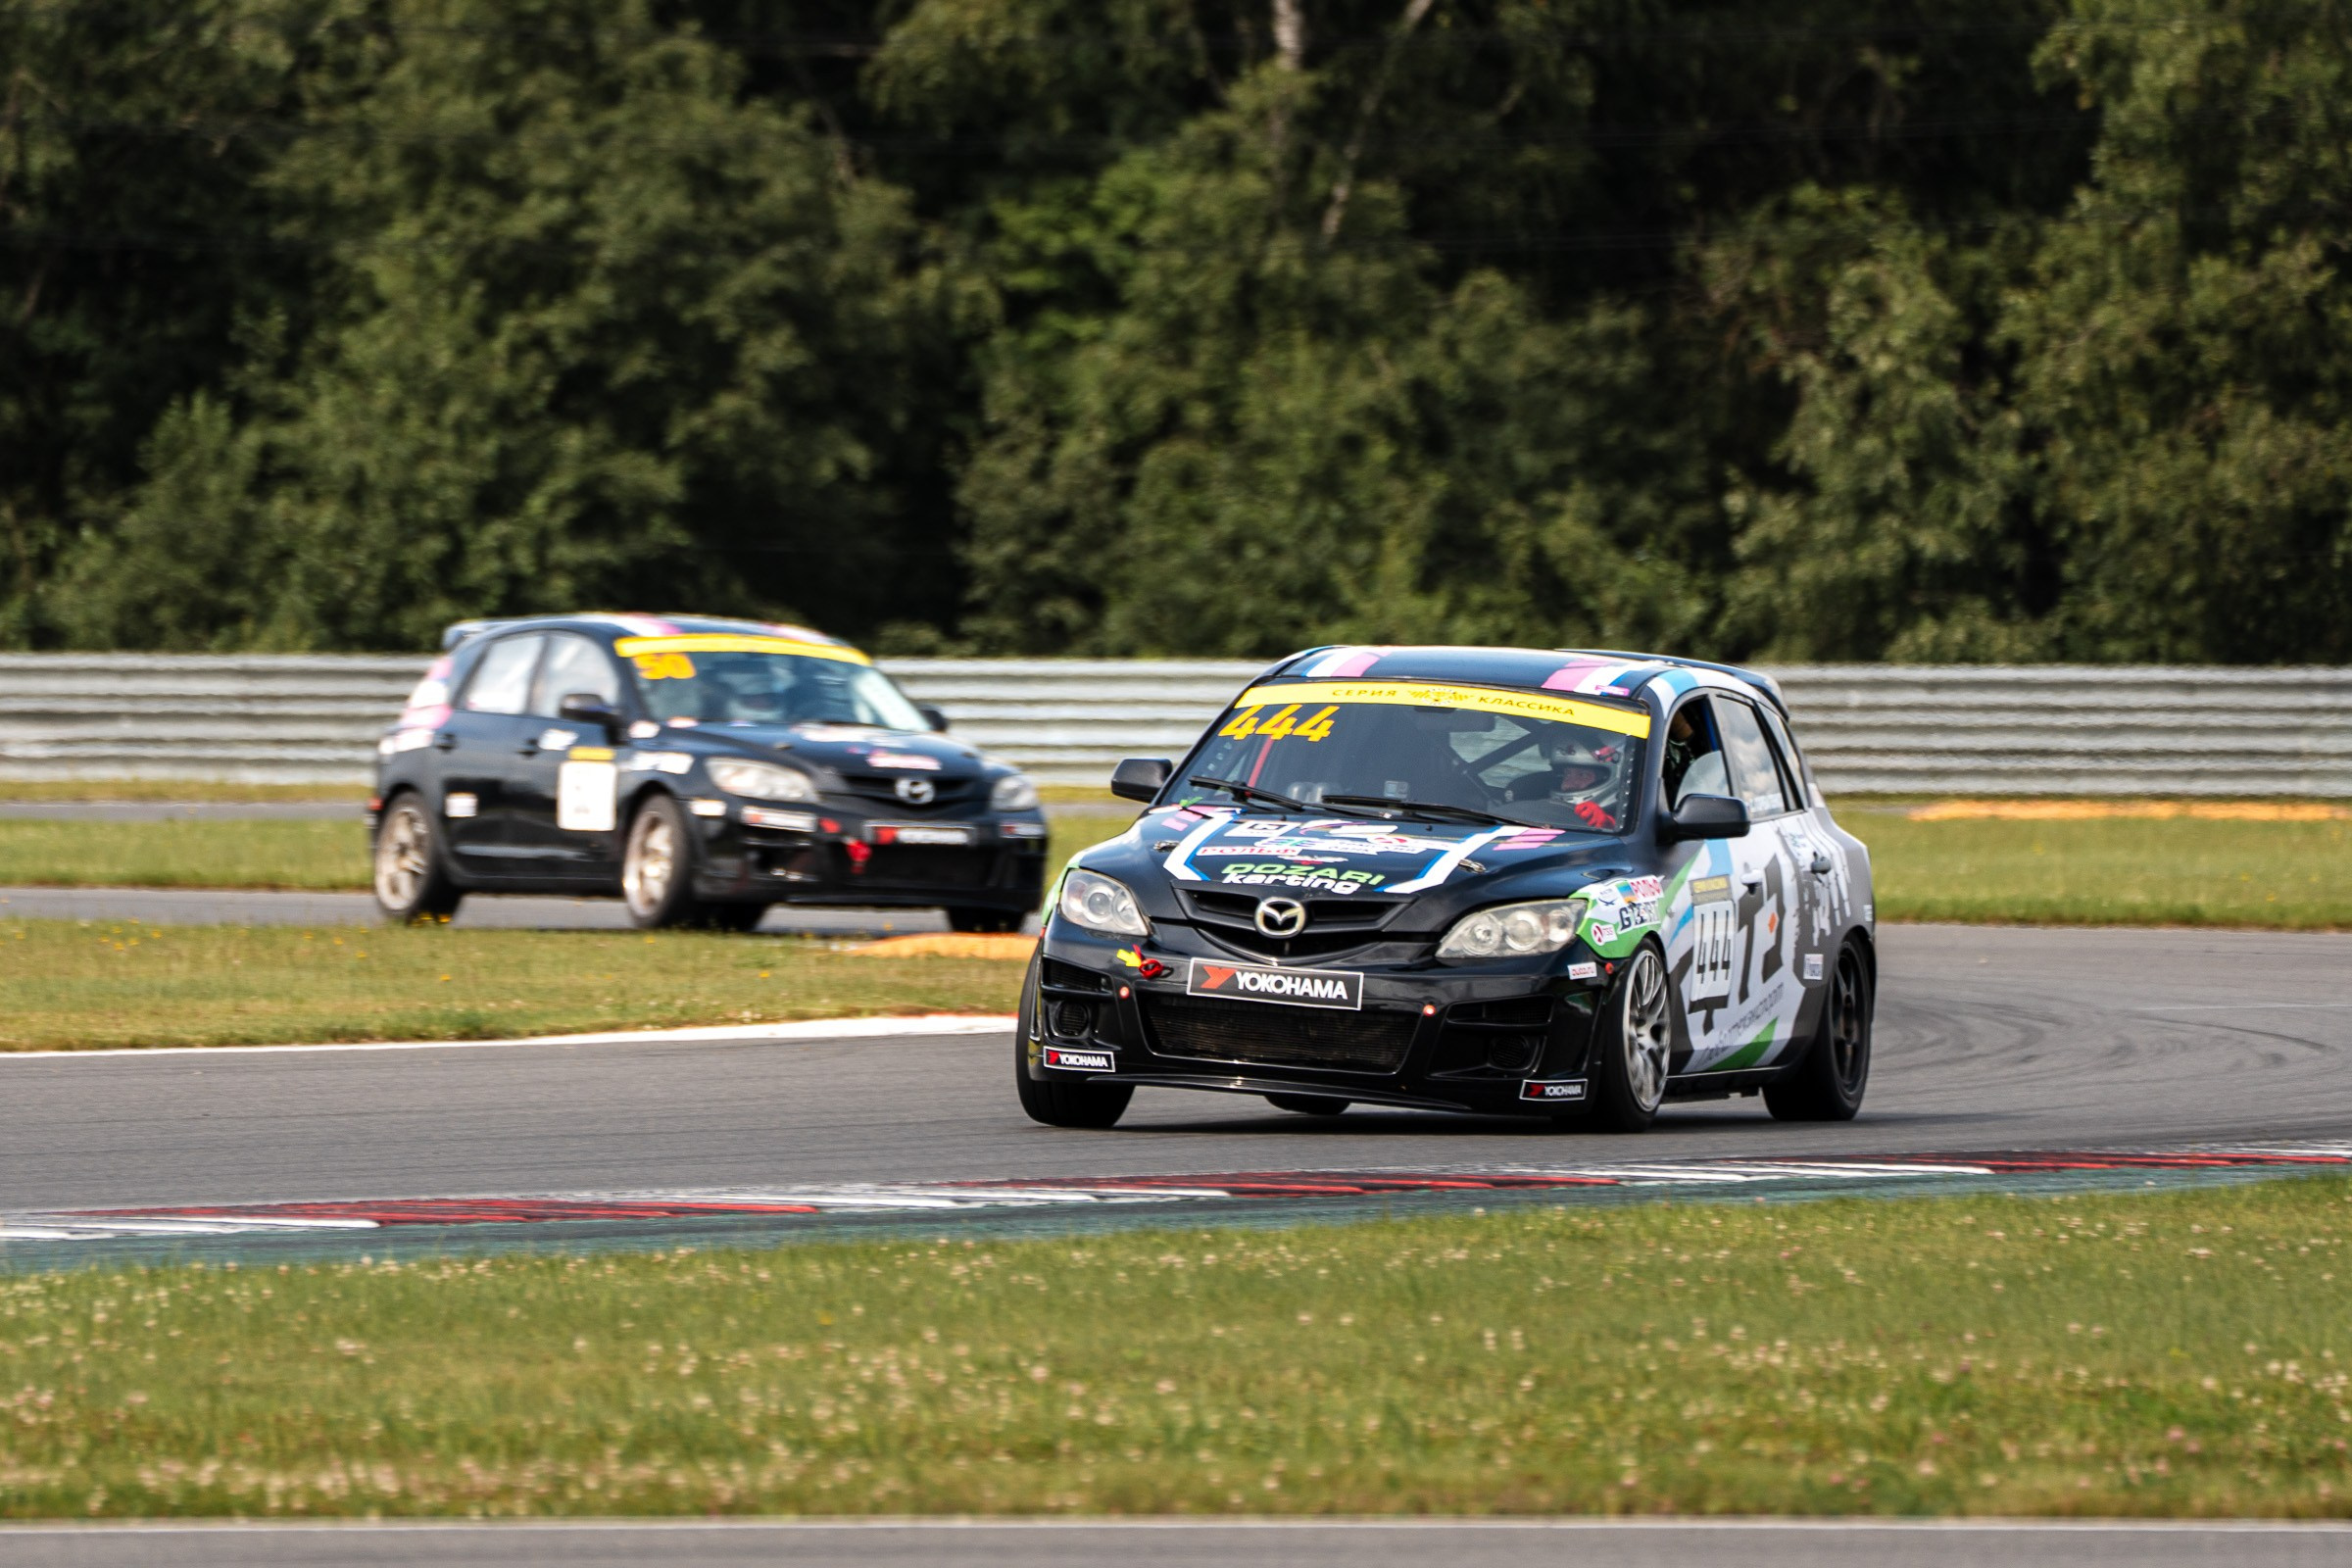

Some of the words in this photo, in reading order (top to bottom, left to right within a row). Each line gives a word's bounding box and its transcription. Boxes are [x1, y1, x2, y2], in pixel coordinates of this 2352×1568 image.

[1332, 689, 1397, 698] СЕРИЯ
[1478, 696, 1575, 716] КЛАССИКА
[1217, 704, 1341, 743] 444
[1200, 847, 1298, 857] РОЛЬФ
[1221, 863, 1386, 886] DOZARI
[1222, 872, 1361, 896] karting
[1696, 909, 1732, 985] 444
[1235, 970, 1348, 1001] YOKOHAMA
[1058, 1053, 1108, 1067] YOKOHAMA
[1544, 1084, 1582, 1097] YOKOHAMA
